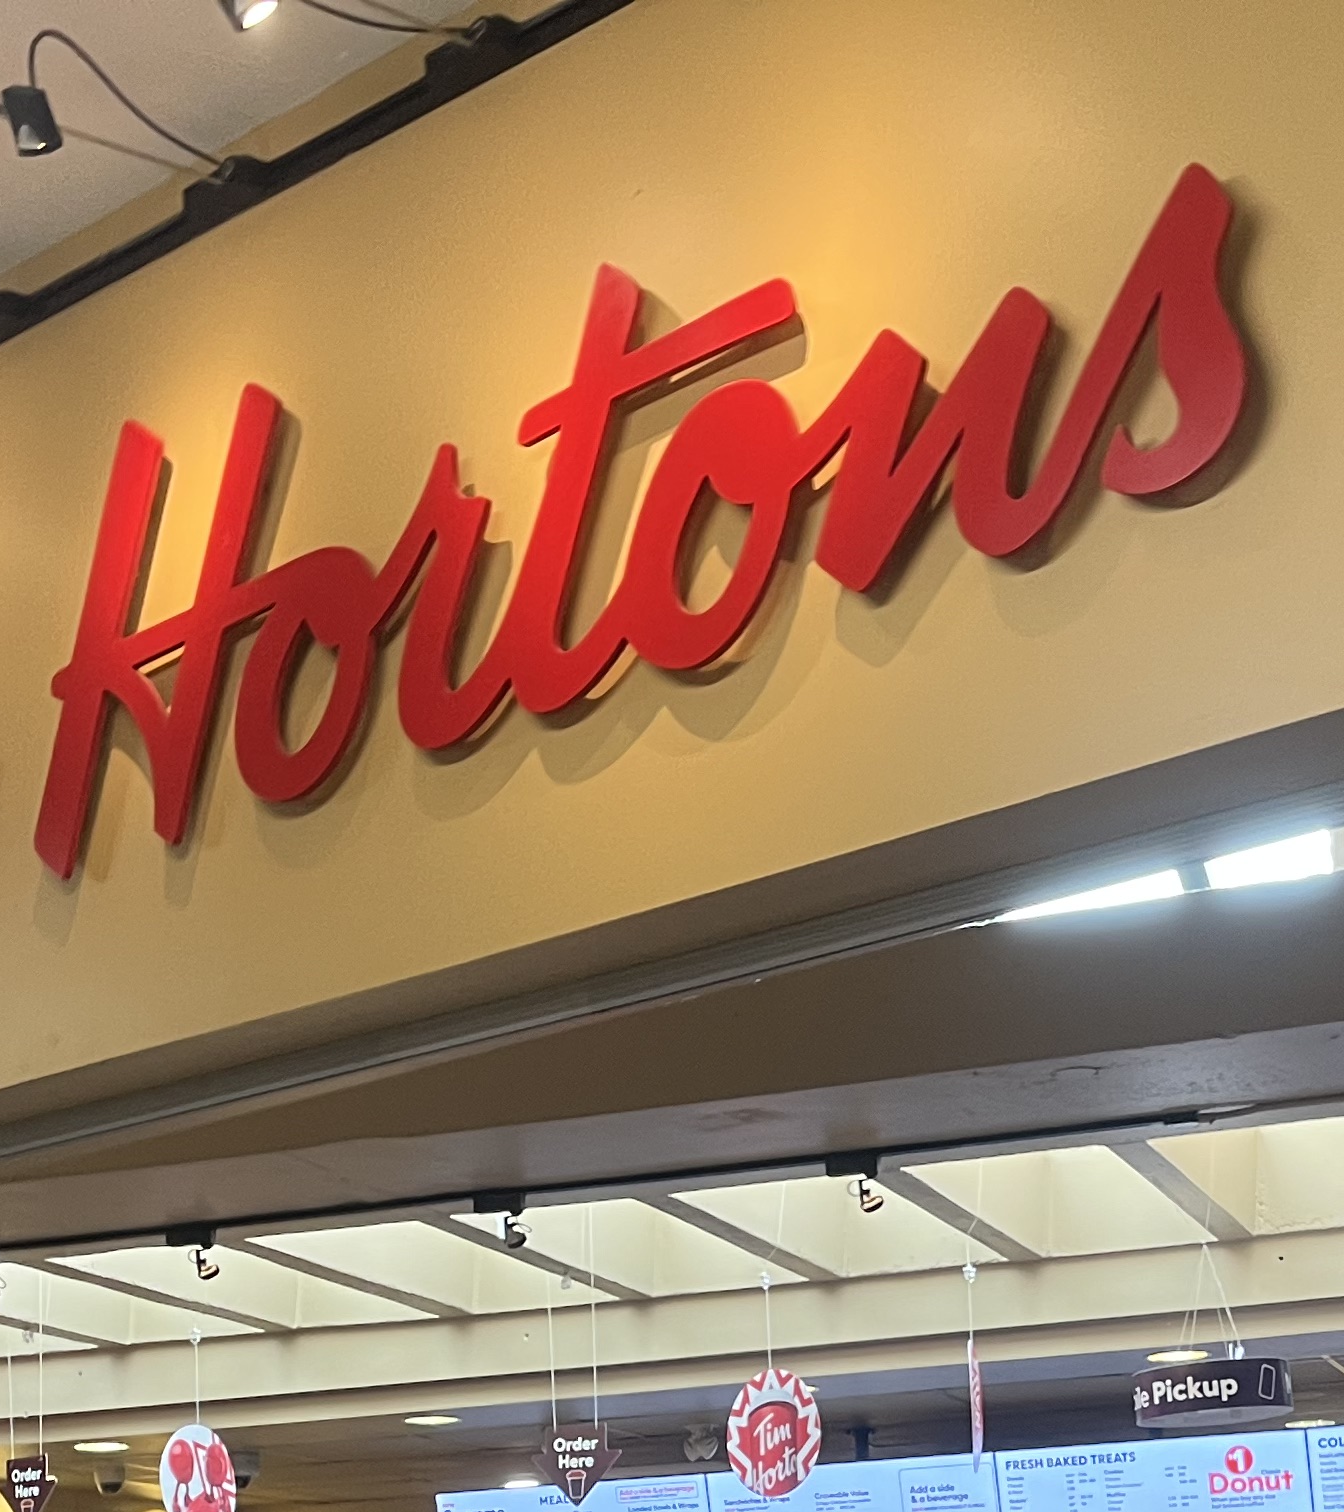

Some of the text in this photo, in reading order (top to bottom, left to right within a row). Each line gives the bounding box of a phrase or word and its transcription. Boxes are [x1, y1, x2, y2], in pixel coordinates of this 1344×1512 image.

[33, 162, 1247, 879] Hortons
[1152, 1376, 1238, 1405] Pickup
[753, 1412, 791, 1456] Tim
[553, 1437, 599, 1452] Order
[558, 1454, 594, 1469] Here
[1005, 1451, 1136, 1470] FRESH BAKED TREATS
[11, 1467, 42, 1483] Order
[1208, 1470, 1293, 1495] Donut
[15, 1485, 40, 1498] Here
[909, 1485, 928, 1494] Add
